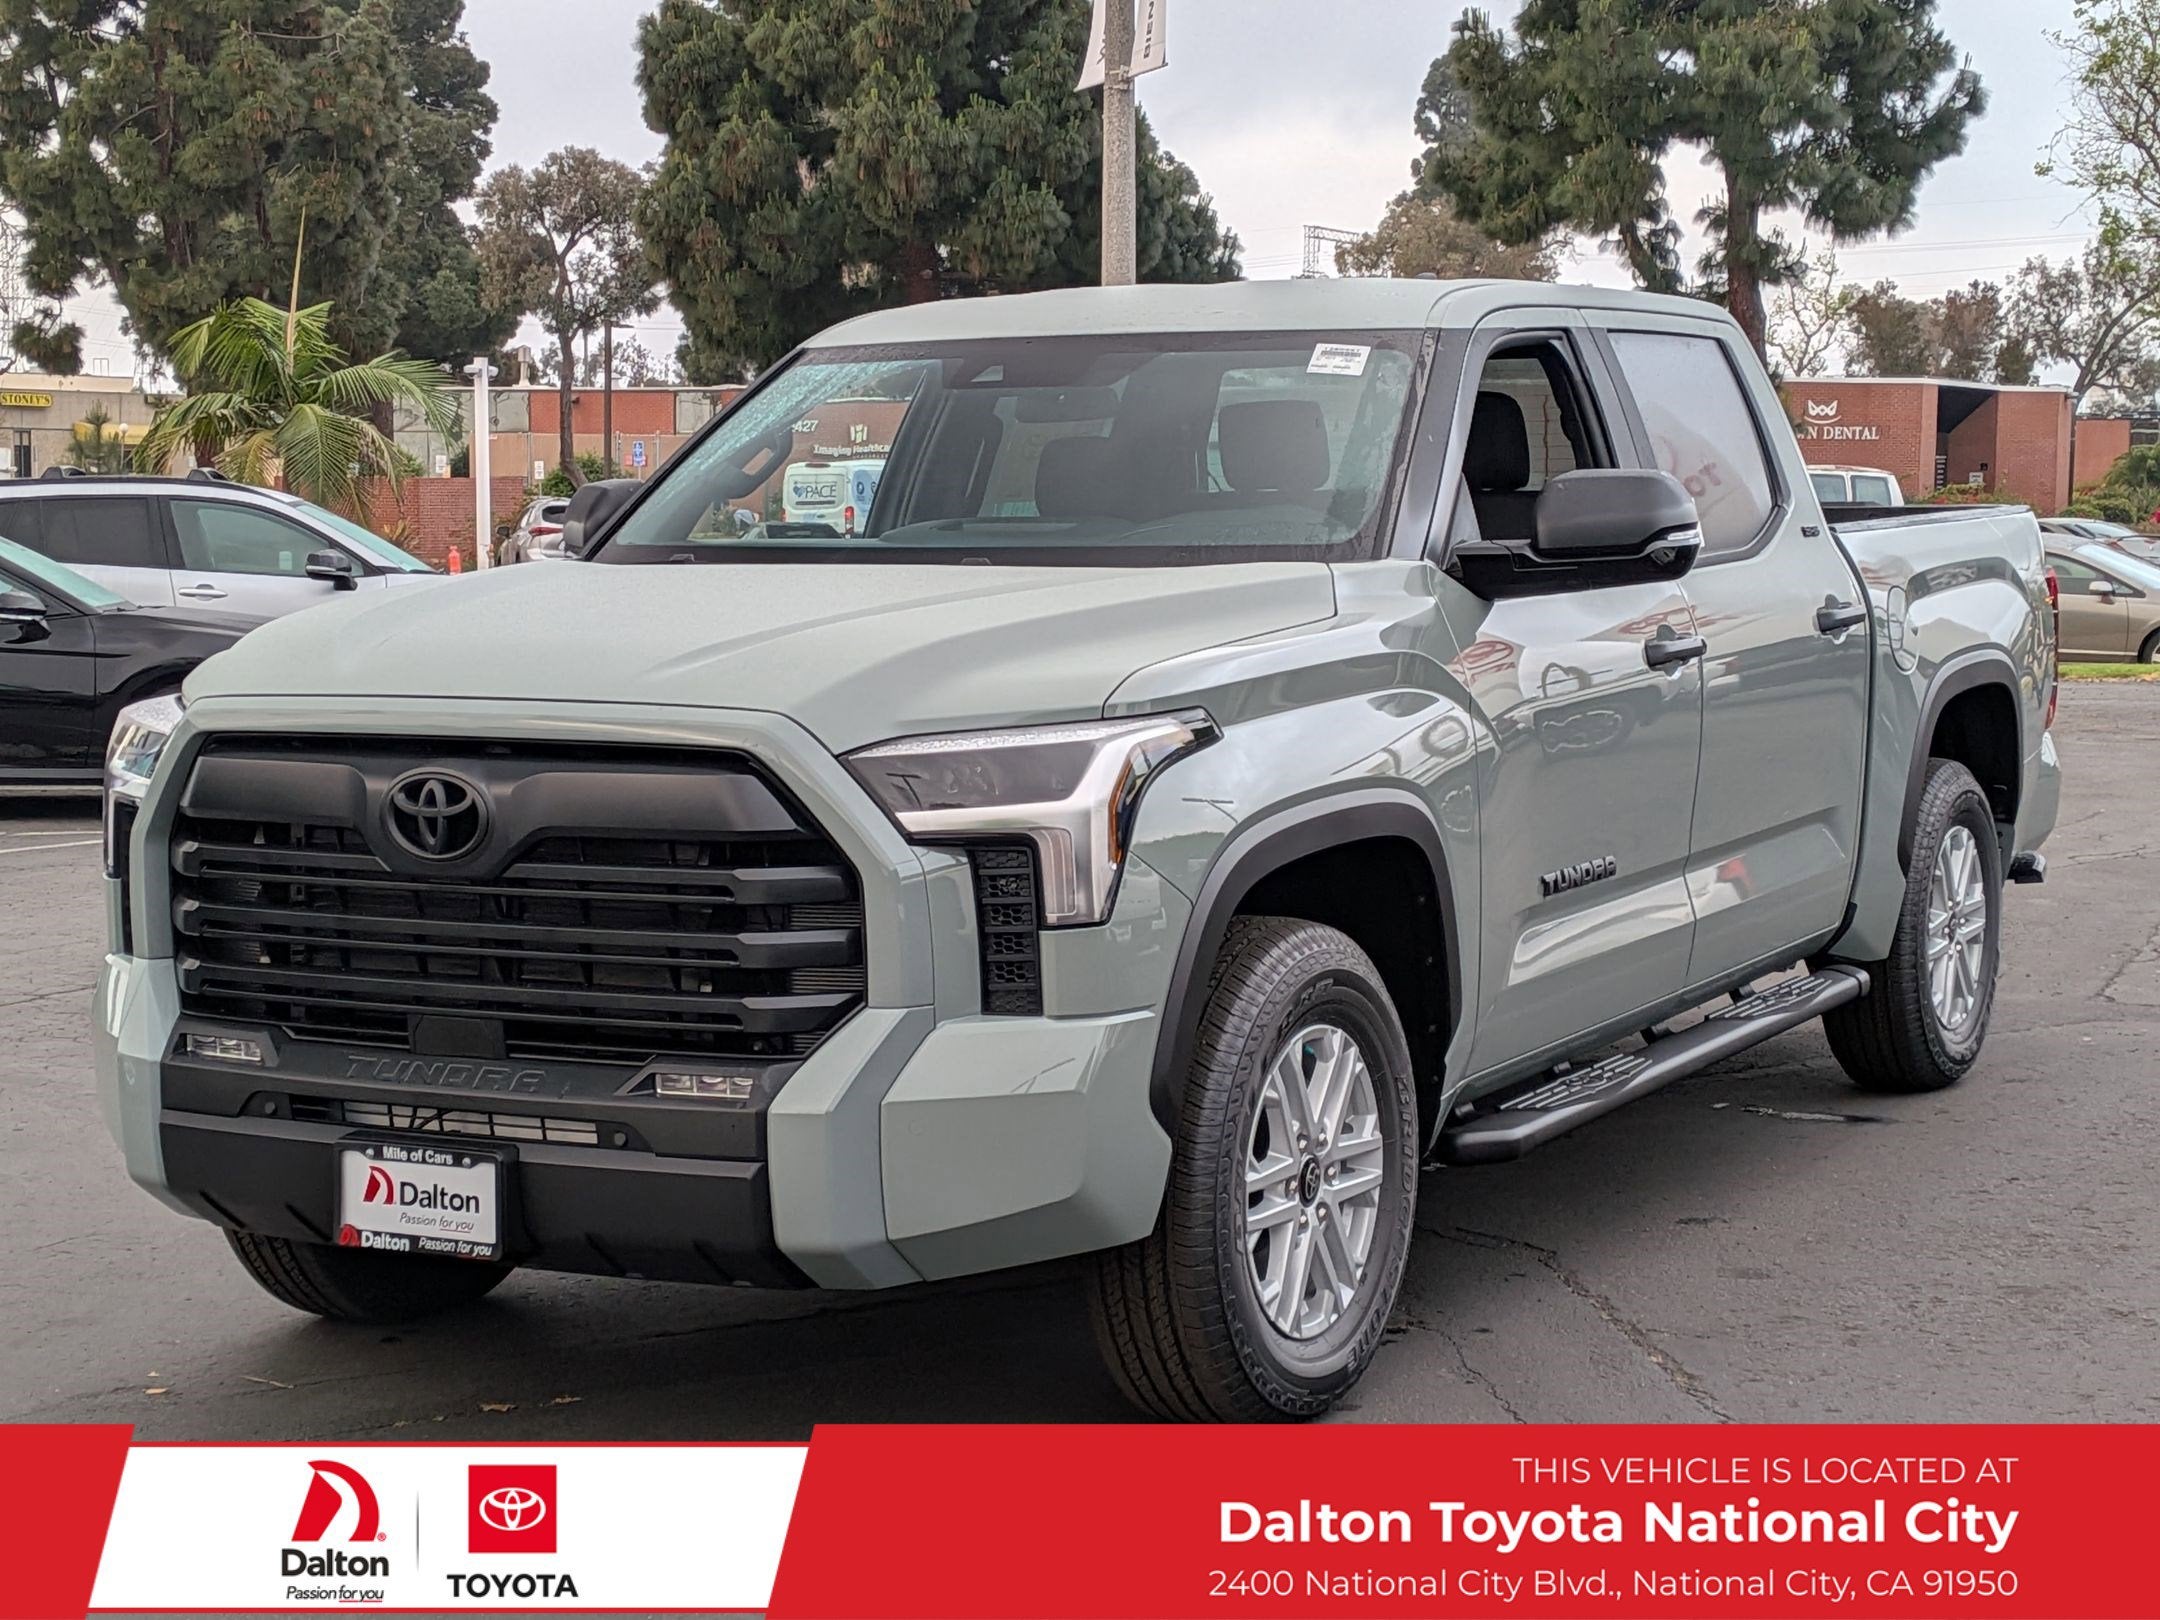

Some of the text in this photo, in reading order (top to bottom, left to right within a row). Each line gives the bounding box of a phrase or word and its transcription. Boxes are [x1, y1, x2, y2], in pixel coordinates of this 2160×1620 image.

[1823, 426, 1879, 440] DENTAL
[805, 485, 837, 499] PACE
[1540, 855, 1617, 897] TUNDRA
[346, 1055, 547, 1093] TUNDRA
[383, 1146, 453, 1165] Mile of Cars
[400, 1181, 480, 1213] Dalton
[400, 1212, 475, 1232] Passion for you
[361, 1231, 493, 1257] Dalton Passion for you
